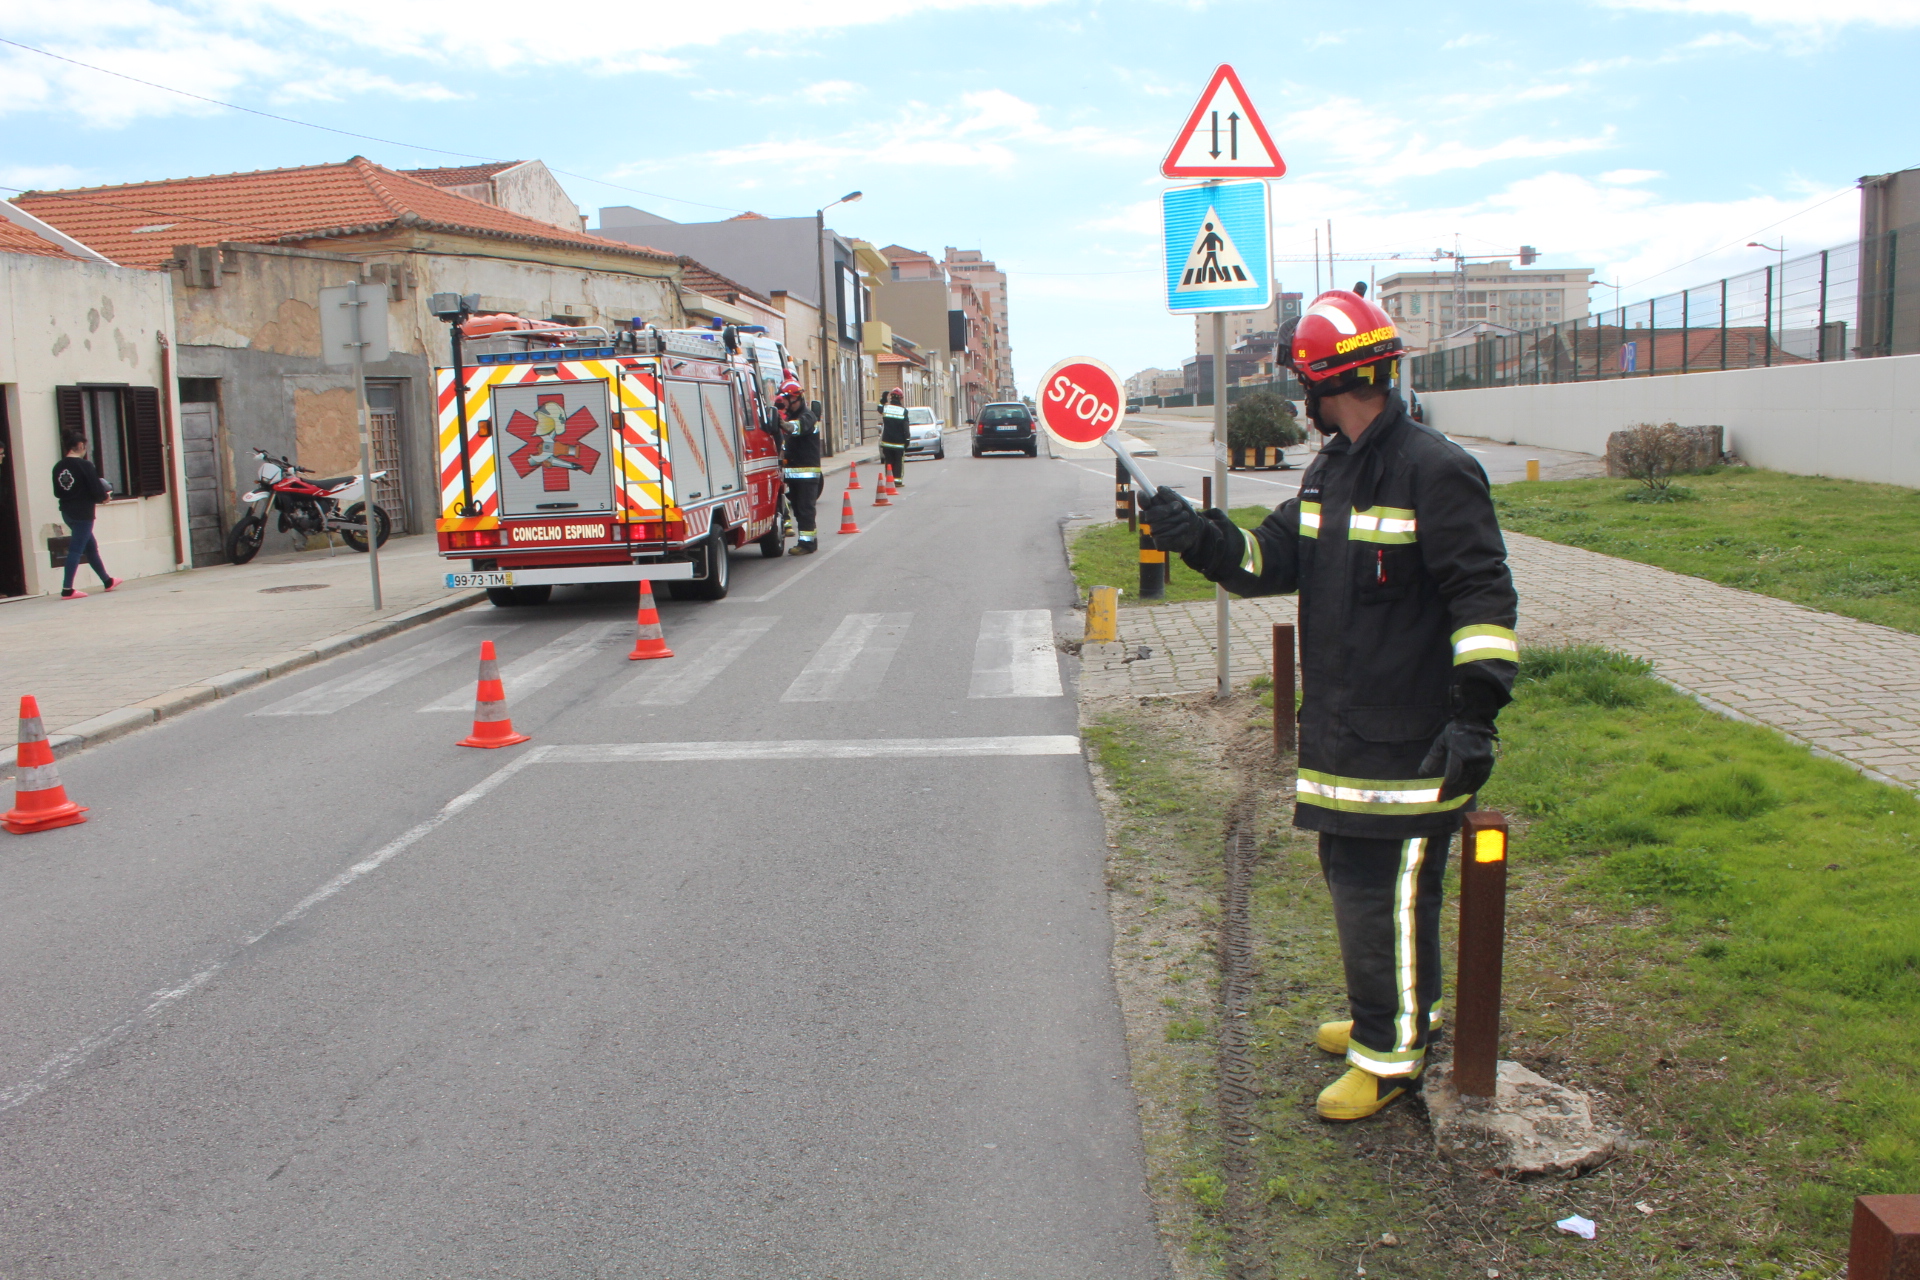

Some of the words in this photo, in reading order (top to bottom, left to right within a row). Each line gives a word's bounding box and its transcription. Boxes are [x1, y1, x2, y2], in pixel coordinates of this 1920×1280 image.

[1047, 375, 1114, 426] STOP
[599, 502, 605, 510] 5
[512, 525, 562, 542] CONCELHO
[565, 523, 605, 540] ESPINHO
